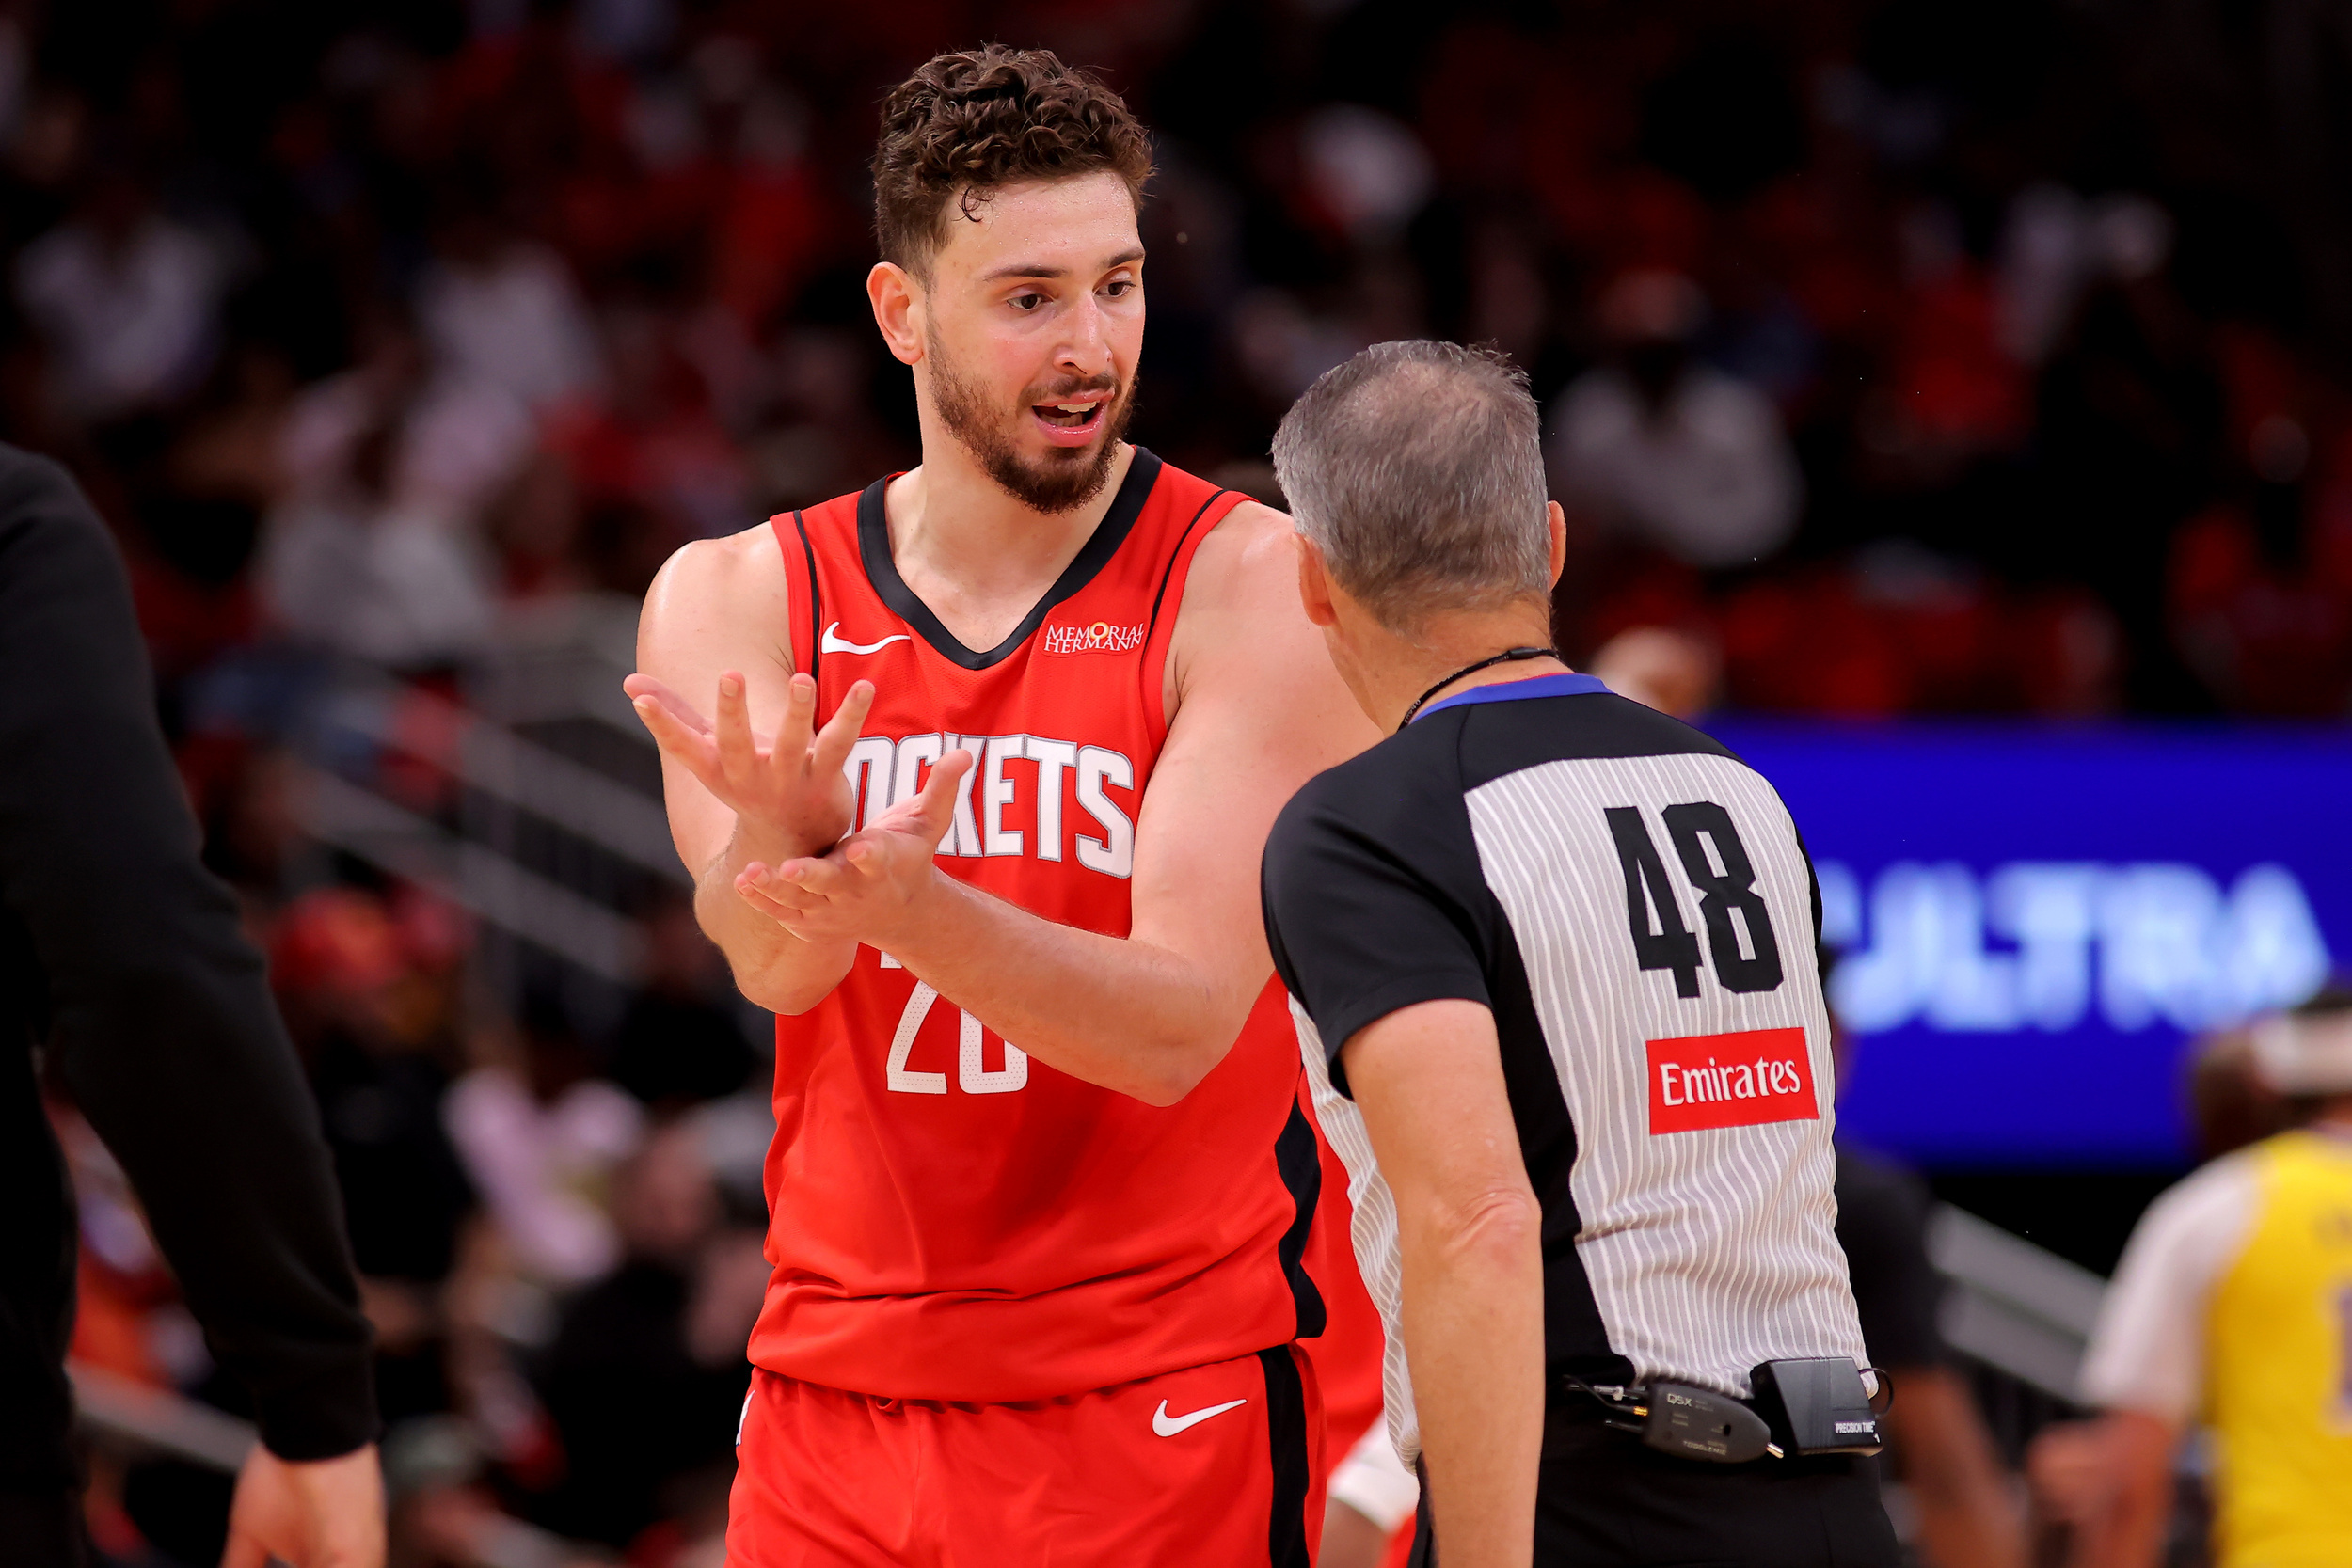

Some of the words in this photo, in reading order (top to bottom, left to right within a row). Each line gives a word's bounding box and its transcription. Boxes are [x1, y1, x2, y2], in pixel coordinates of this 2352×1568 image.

[1046, 622, 1144, 641] MEMORIAL
[1043, 634, 1143, 654] HERMANN
[840, 731, 1135, 879] OCKETS
[1603, 800, 1784, 999] 48
[1659, 1056, 1801, 1106] Emirates
[1666, 1392, 1692, 1408] Q5X
[1835, 1422, 1862, 1434] PRECISION
